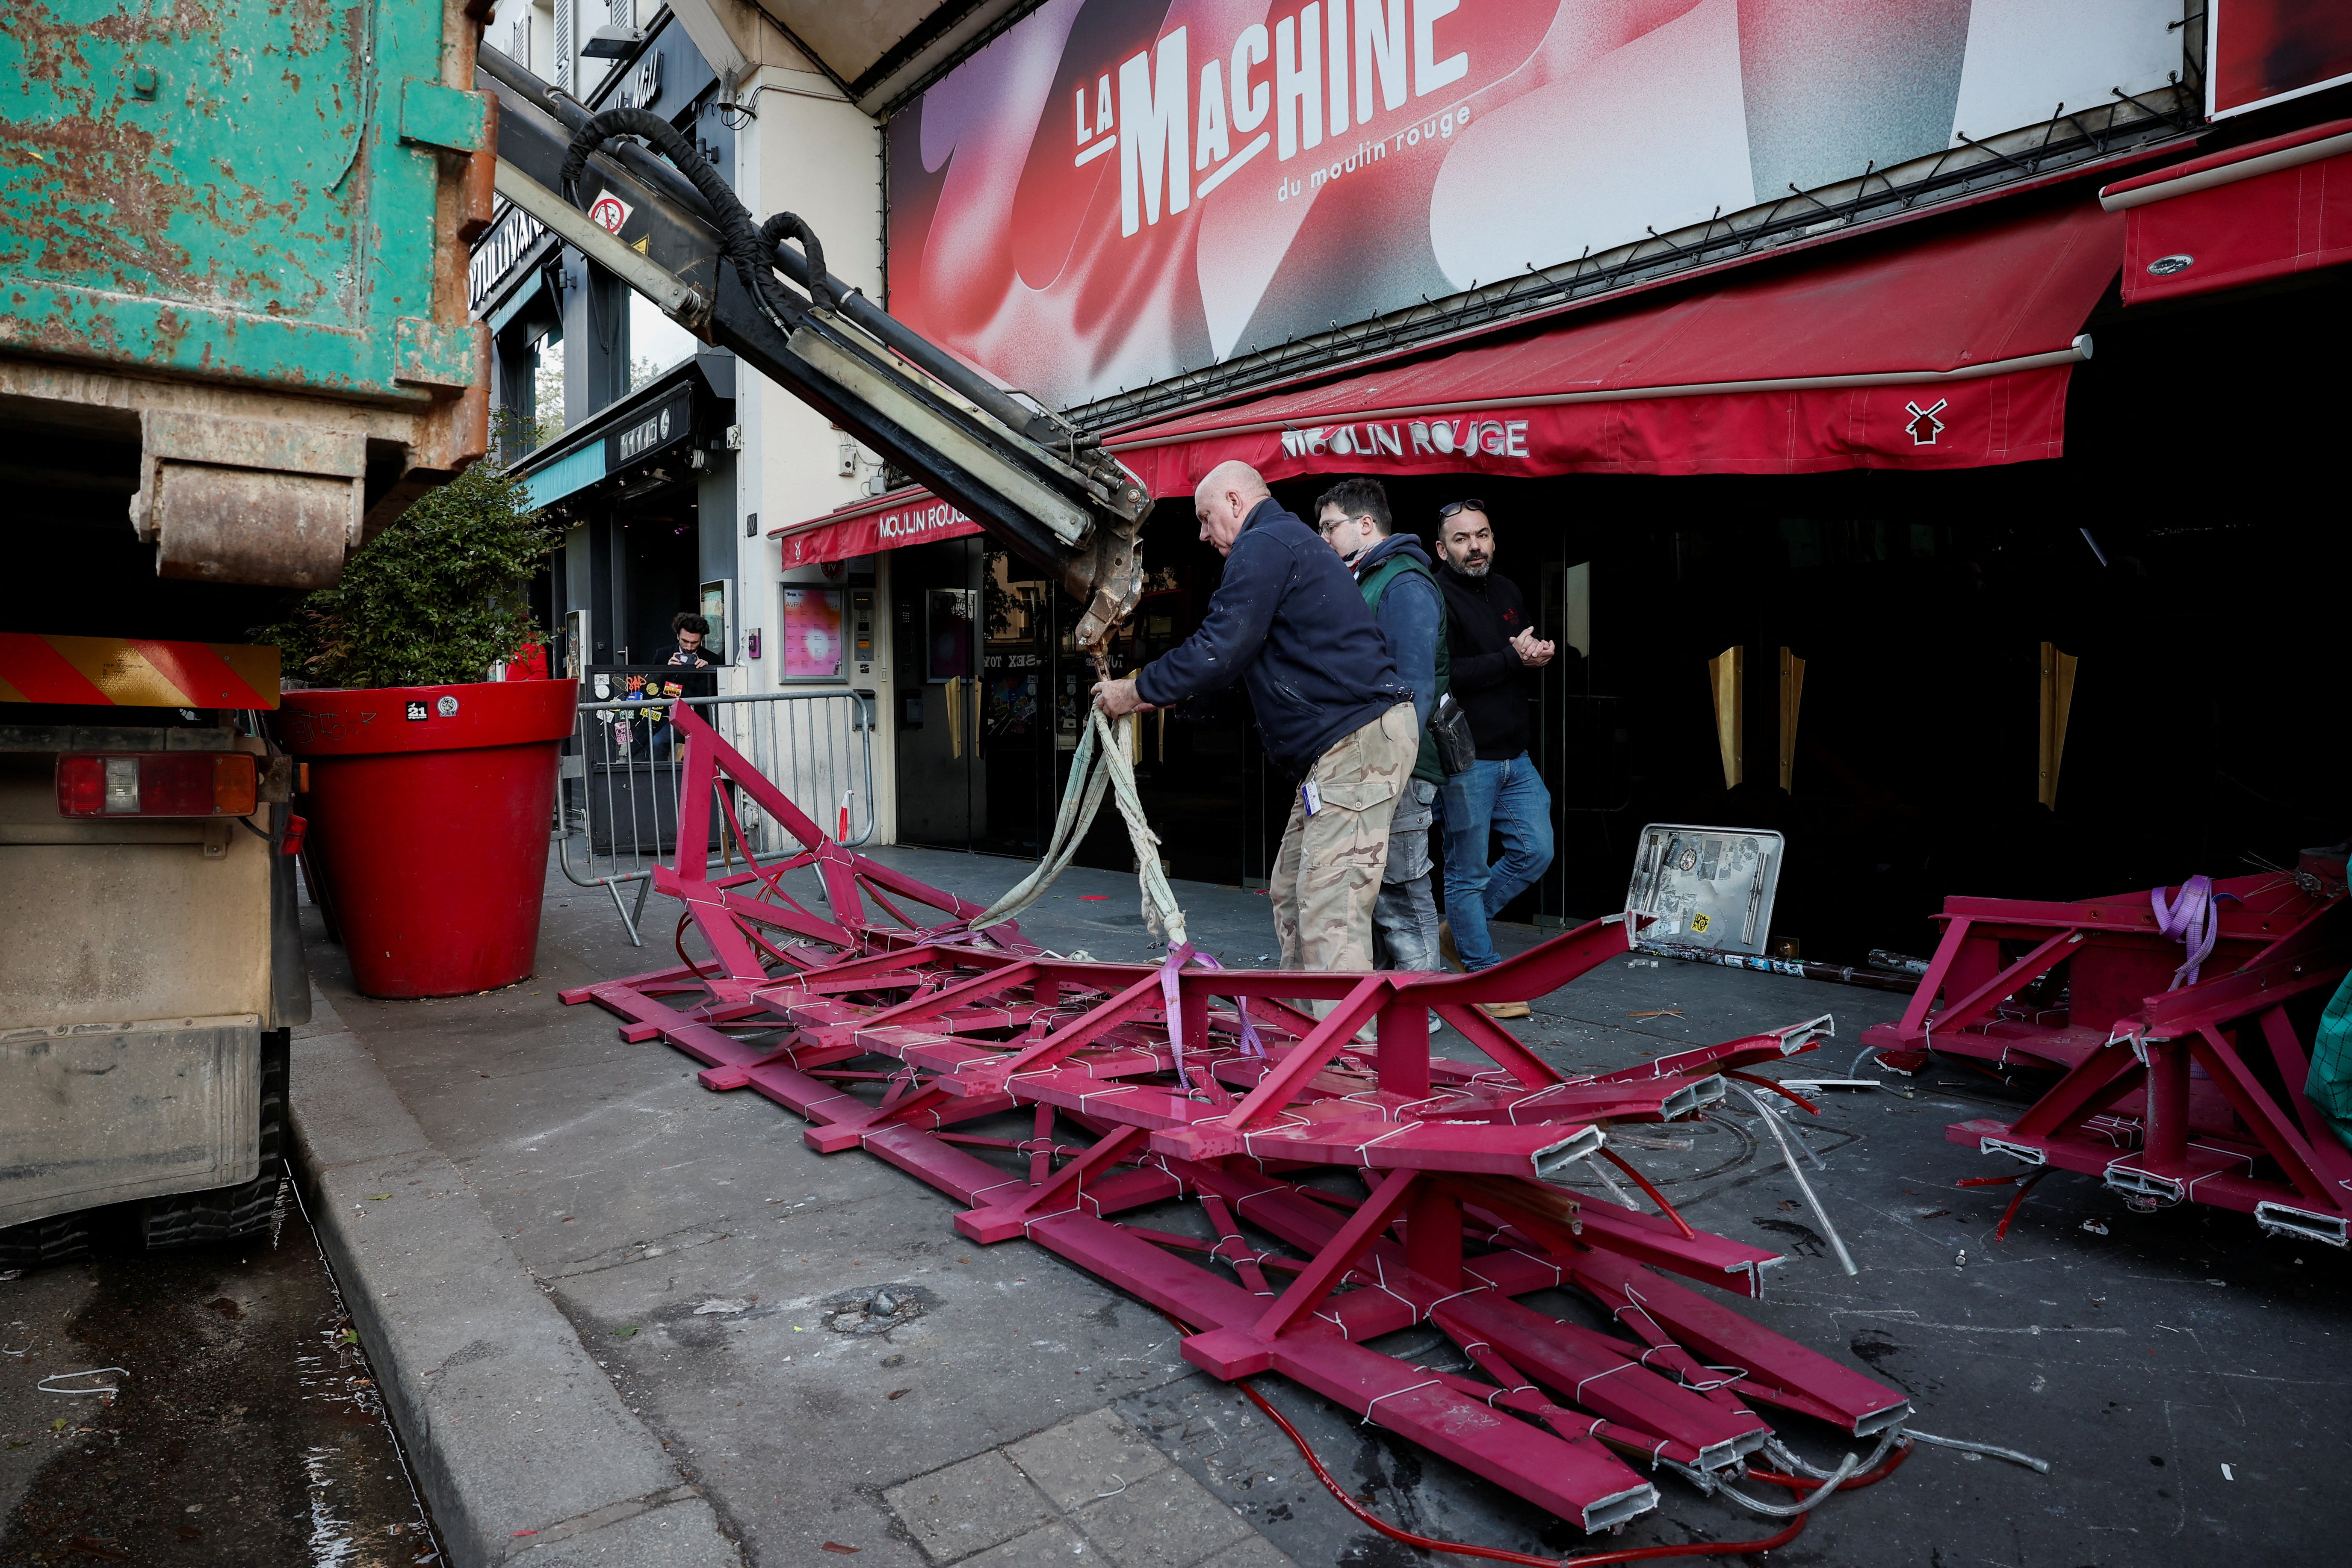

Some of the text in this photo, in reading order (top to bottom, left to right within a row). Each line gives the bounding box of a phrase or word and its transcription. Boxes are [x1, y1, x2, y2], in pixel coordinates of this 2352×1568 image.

[1076, 0, 1469, 239] LA MACHINE
[1278, 104, 1471, 202] du moulin rouge
[1281, 419, 1530, 458] MOULIN ROUGE
[880, 503, 972, 537] MOULIN ROUG
[408, 707, 427, 717] 21
